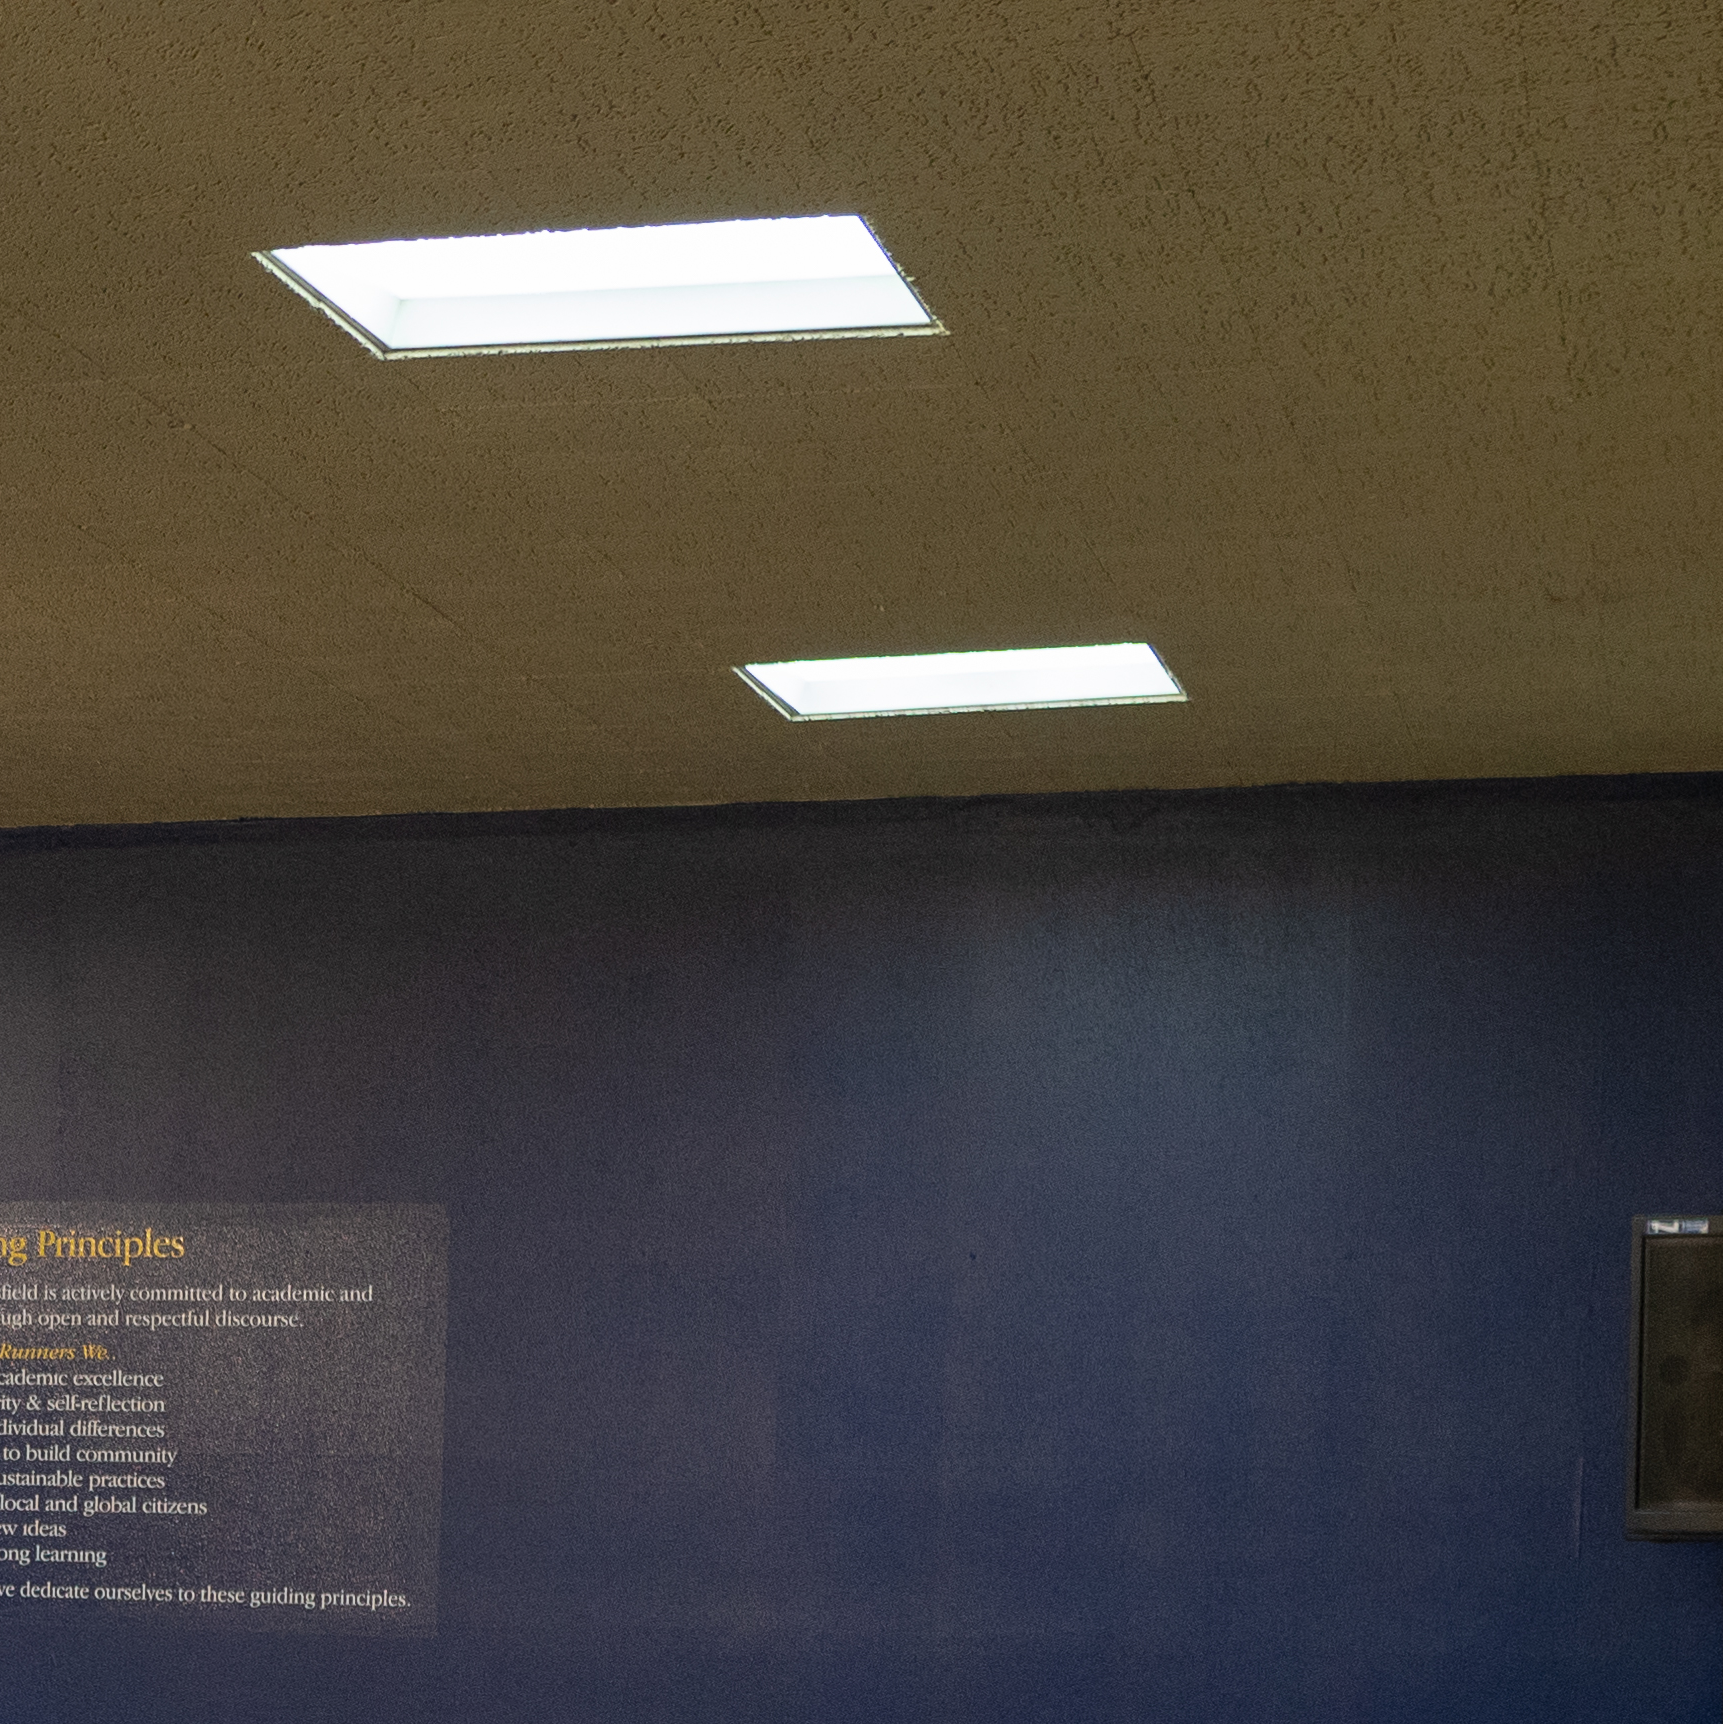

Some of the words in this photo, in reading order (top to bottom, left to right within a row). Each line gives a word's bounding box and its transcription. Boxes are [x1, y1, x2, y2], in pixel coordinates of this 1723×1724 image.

[37, 1226, 186, 1267] Principles
[44, 1286, 58, 1301] is
[61, 1285, 125, 1306] actively
[129, 1285, 223, 1302] committed
[229, 1287, 248, 1302] to
[251, 1285, 337, 1302] academic
[339, 1285, 374, 1302] and
[37, 1315, 82, 1332] open
[86, 1310, 120, 1327] and
[124, 1311, 211, 1332] respectful
[214, 1311, 304, 1328] discourse.
[72, 1371, 165, 1388] excellence
[25, 1395, 42, 1411] &
[46, 1395, 166, 1413] self-reflection
[69, 1420, 166, 1438] differences
[2, 1447, 21, 1461] to
[25, 1445, 71, 1462] build
[75, 1447, 178, 1468] community
[88, 1473, 166, 1494] practices
[0, 1495, 40, 1512] local
[44, 1496, 78, 1513] and
[82, 1497, 137, 1519] global
[141, 1499, 209, 1515] citizens
[22, 1520, 67, 1537] ideas
[35, 1545, 108, 1568] learning
[19, 1580, 90, 1599] dedicate
[93, 1582, 173, 1601] ourselves
[177, 1587, 196, 1602] to
[199, 1585, 245, 1603] these
[249, 1586, 316, 1610] guiding
[320, 1588, 412, 1612] principles.
